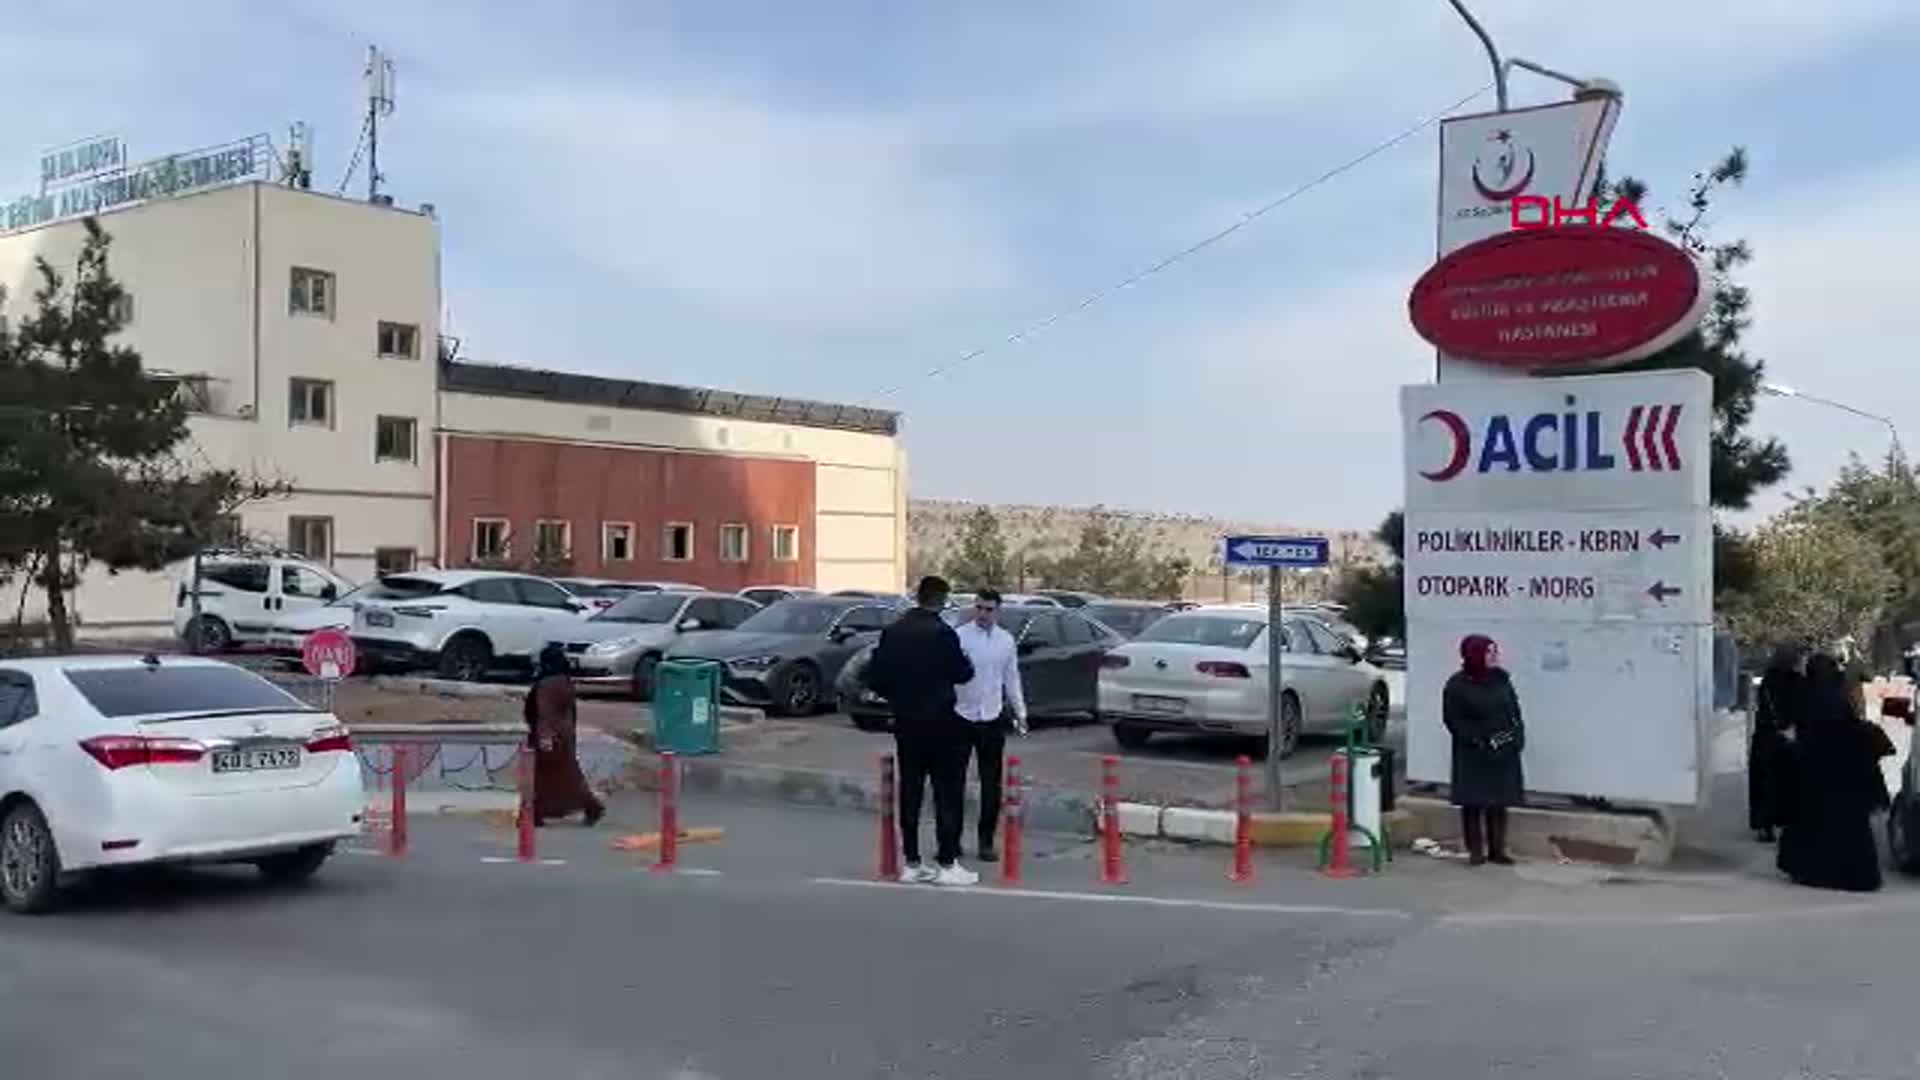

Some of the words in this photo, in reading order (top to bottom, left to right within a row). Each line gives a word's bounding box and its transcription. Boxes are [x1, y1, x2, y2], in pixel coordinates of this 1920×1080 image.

[1477, 394, 1615, 473] ACİL
[1580, 530, 1640, 551] KBRN
[1417, 575, 1509, 598] OTOPARK
[1529, 577, 1595, 599] MORG
